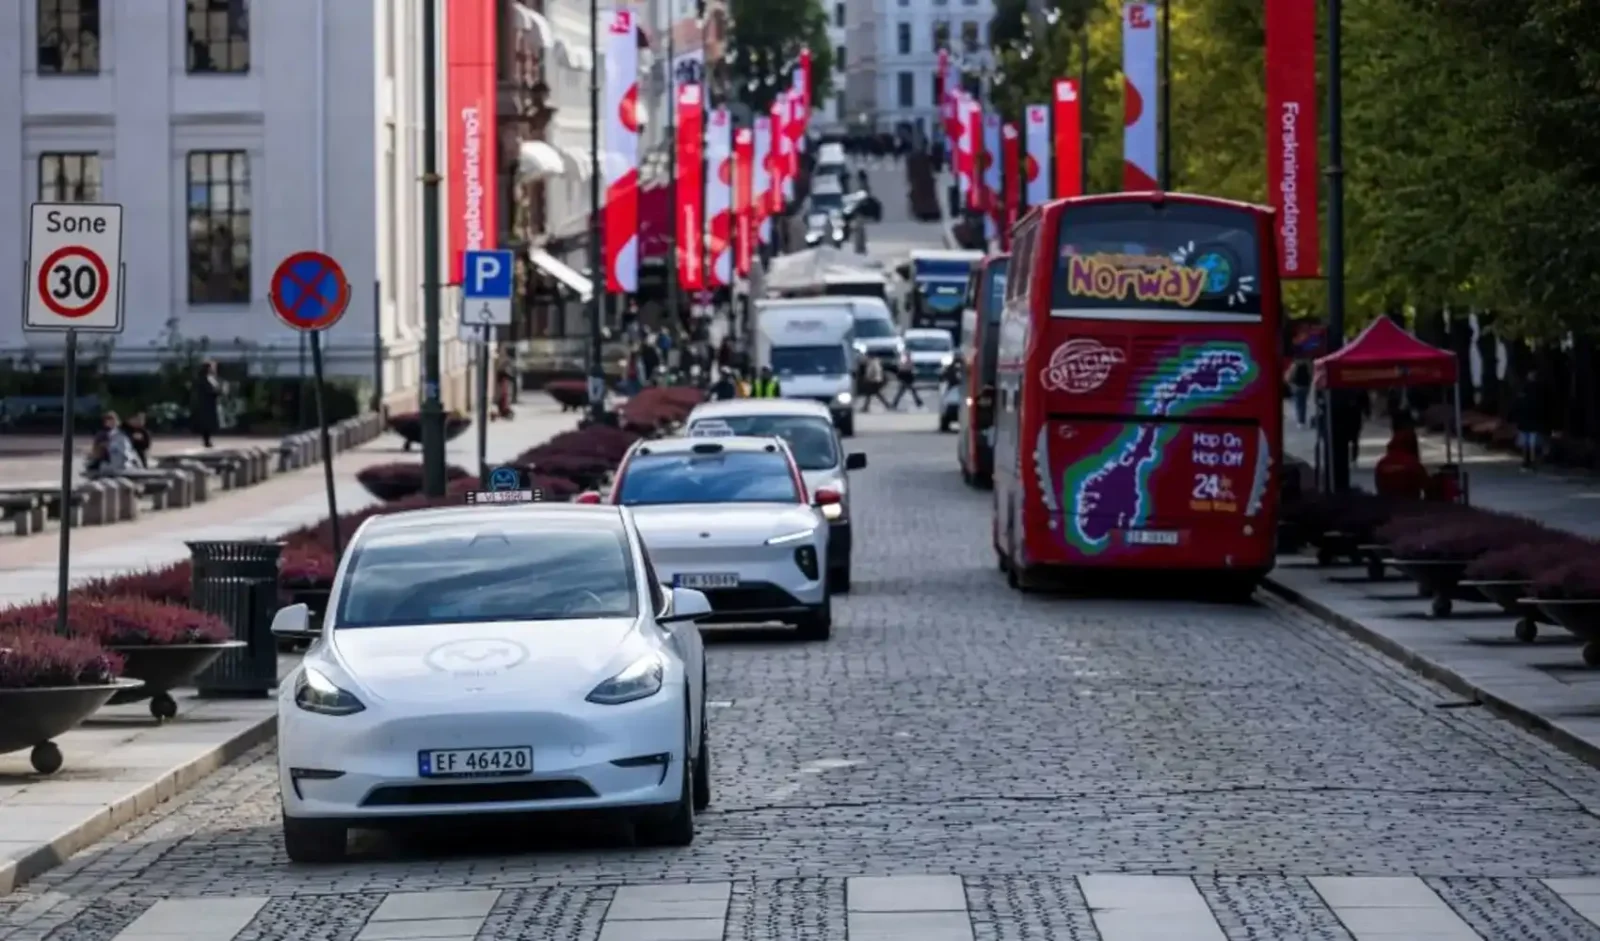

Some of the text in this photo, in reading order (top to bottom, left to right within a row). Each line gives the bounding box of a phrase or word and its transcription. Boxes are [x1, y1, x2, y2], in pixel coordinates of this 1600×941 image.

[1280, 102, 1300, 271] Forskningsdagene
[47, 211, 106, 233] Sone
[53, 264, 96, 299] 30
[475, 256, 501, 293] P
[1068, 254, 1208, 307] Norway
[1193, 432, 1243, 448] Hop On
[1192, 449, 1220, 467] Hop
[1191, 473, 1219, 498] 24
[436, 751, 527, 771] EF 46420
